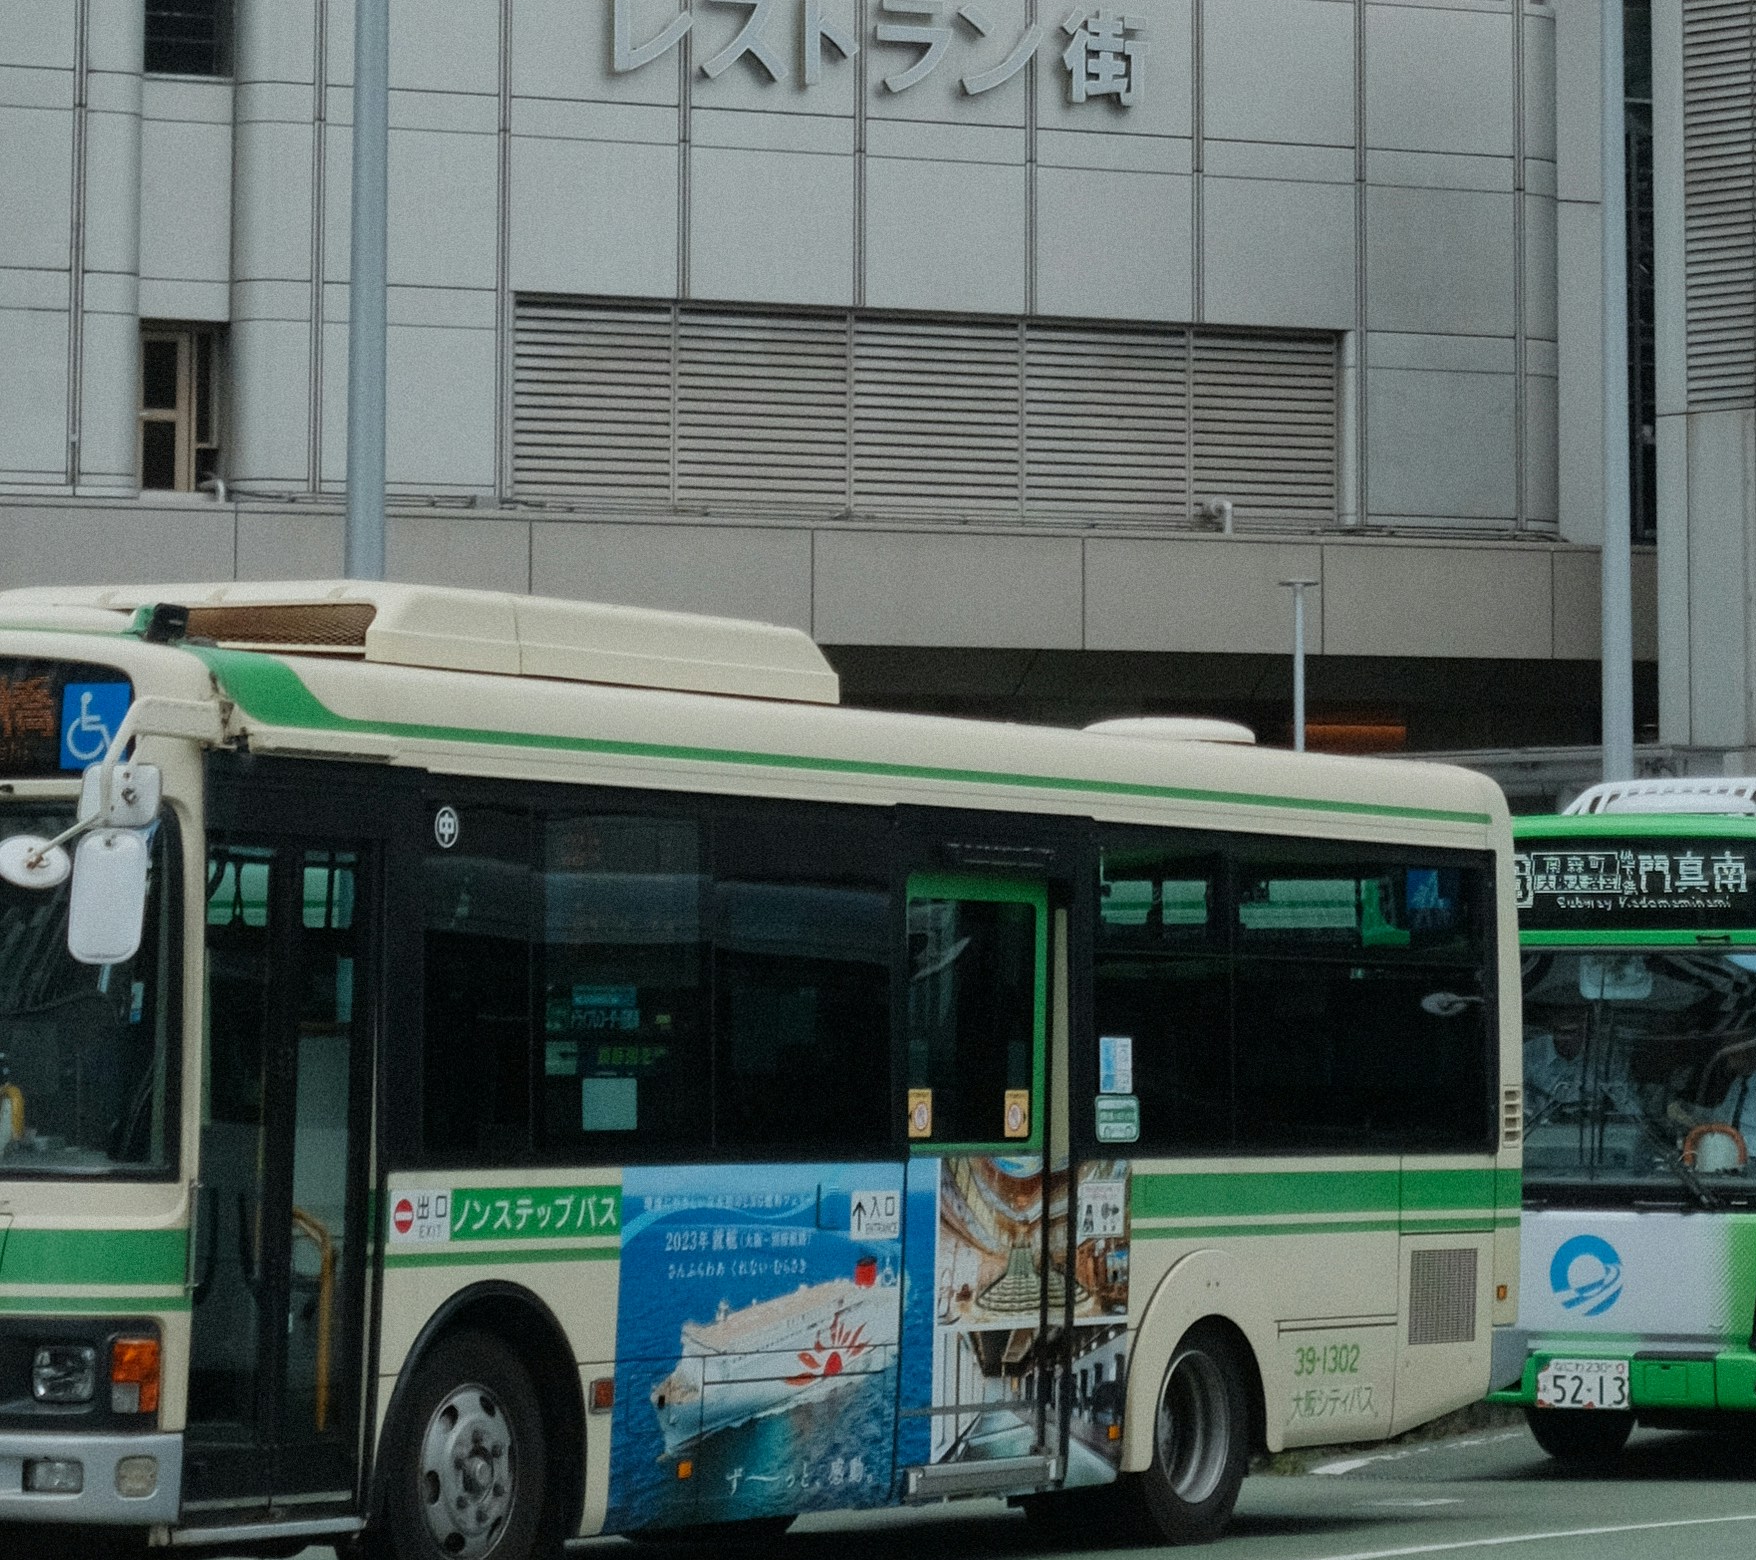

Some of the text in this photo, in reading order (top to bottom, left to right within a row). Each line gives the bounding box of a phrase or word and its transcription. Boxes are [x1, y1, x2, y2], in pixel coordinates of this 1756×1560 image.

[1638, 850, 1748, 894] 門真南
[1556, 896, 1613, 912] Subway
[417, 1195, 448, 1220] 出口
[453, 1194, 618, 1232] ノンステップバス
[869, 1195, 895, 1220] 入口
[1285, 1385, 1379, 1426] 大阪シティバス
